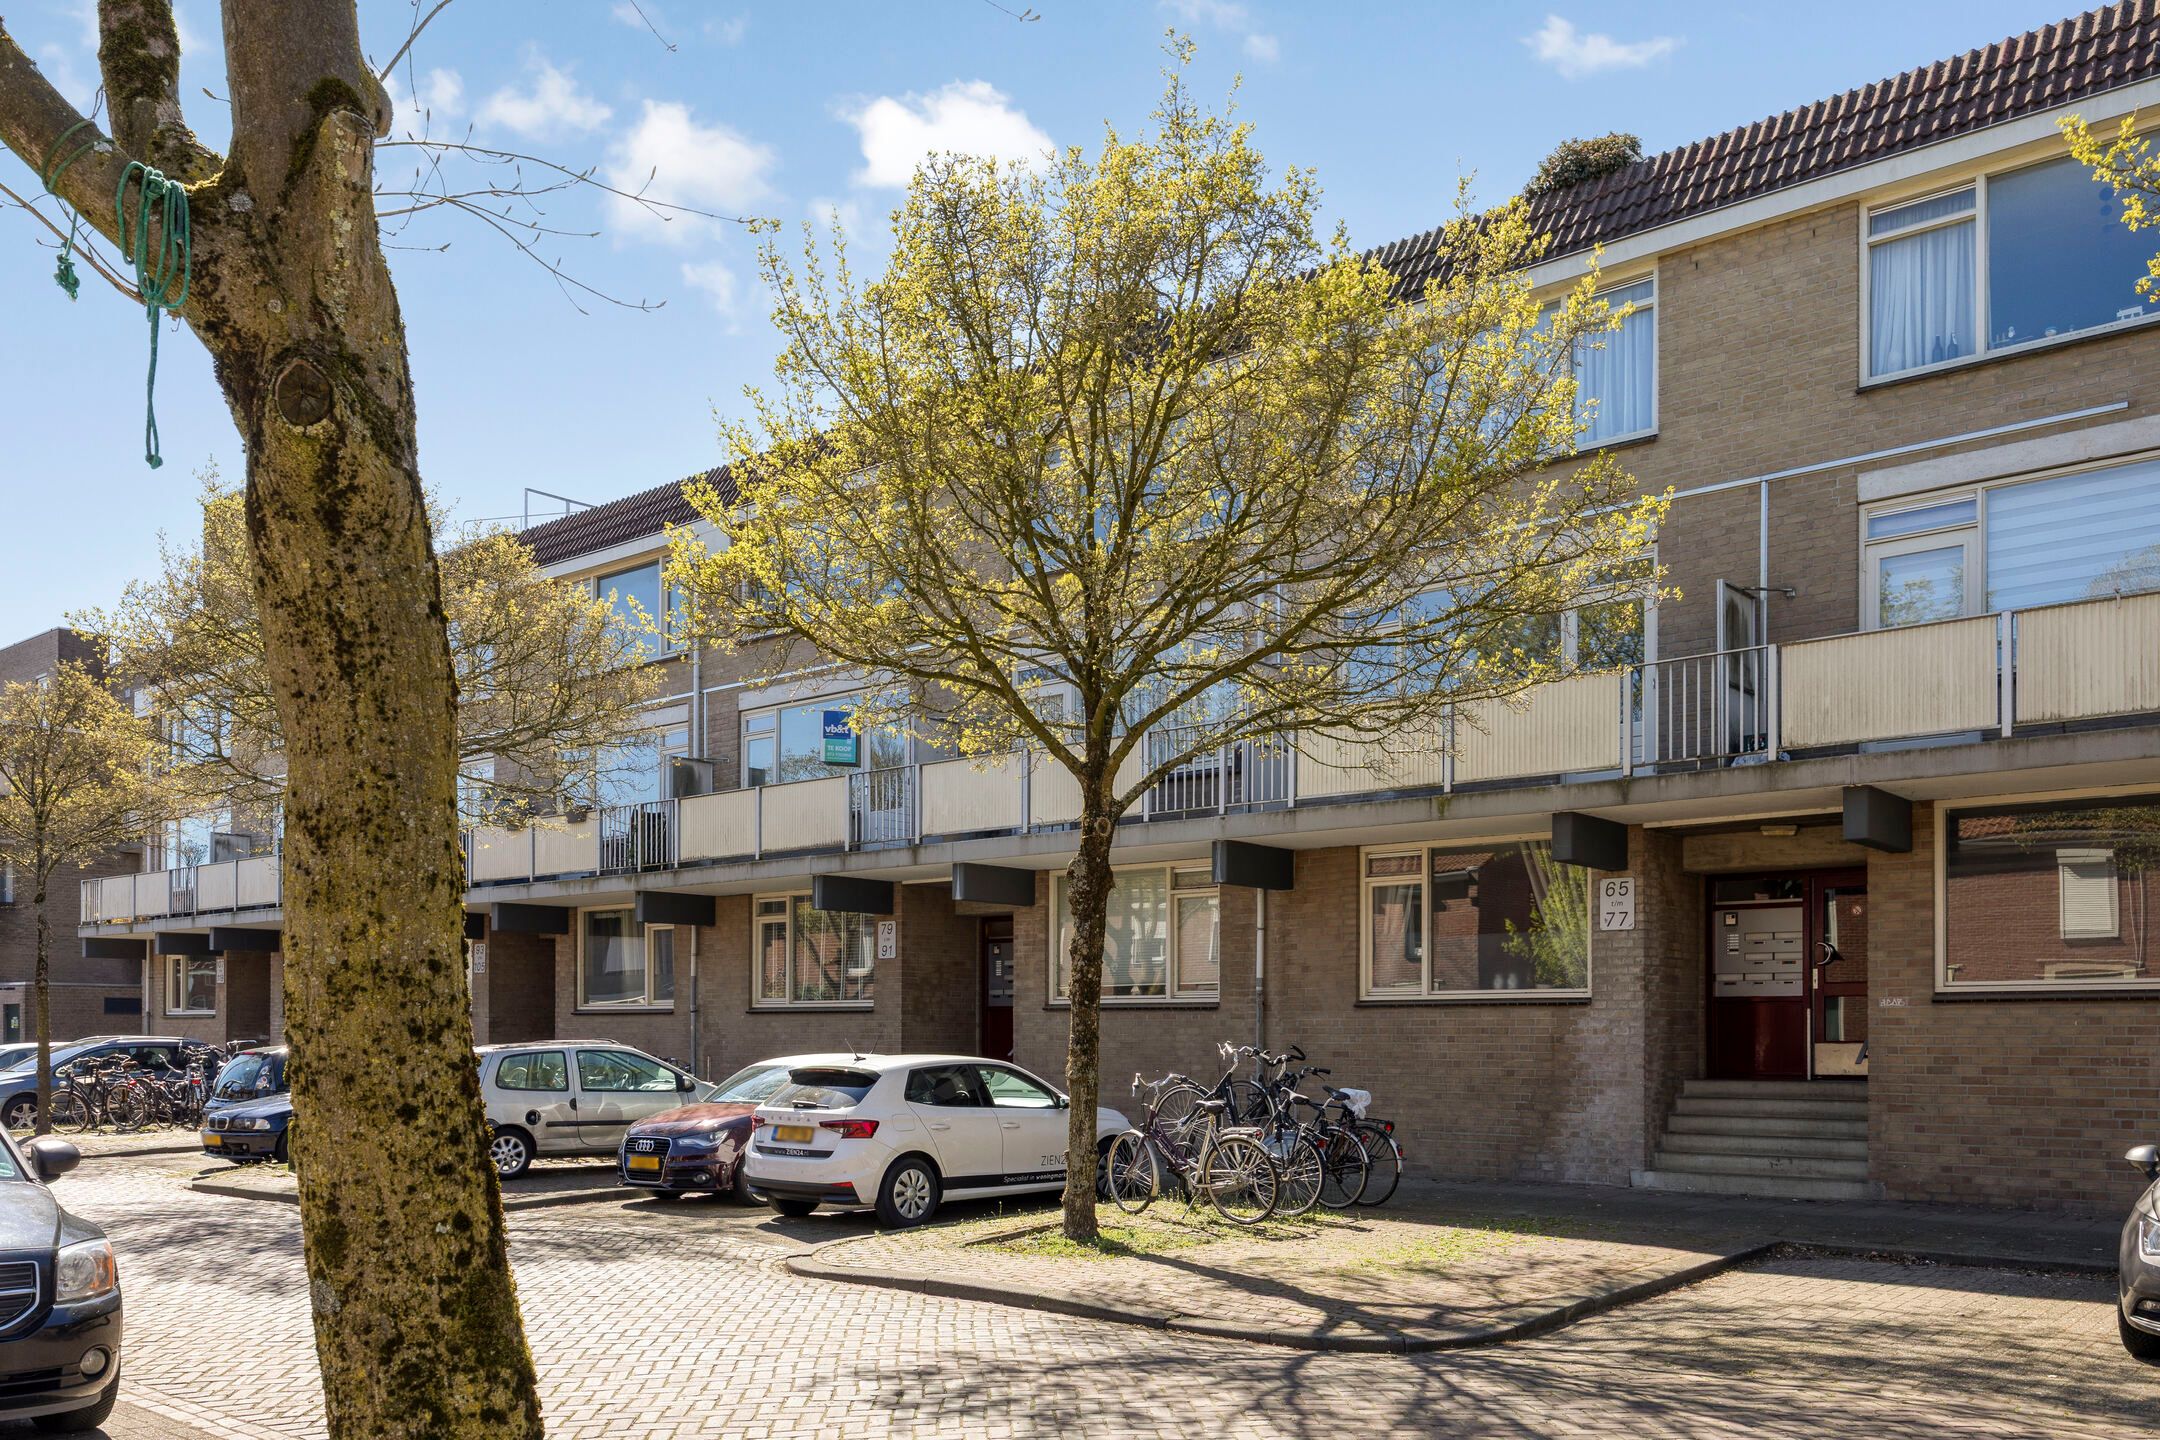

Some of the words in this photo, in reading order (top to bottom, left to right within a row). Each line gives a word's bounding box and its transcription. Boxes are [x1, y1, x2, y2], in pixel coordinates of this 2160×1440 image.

[1605, 880, 1629, 897] 65
[1606, 911, 1629, 928] 77
[881, 923, 893, 935] 79
[475, 945, 485, 955] 93
[881, 944, 893, 957] 91
[474, 961, 486, 971] 105
[1003, 1174, 1029, 1183] Specialist
